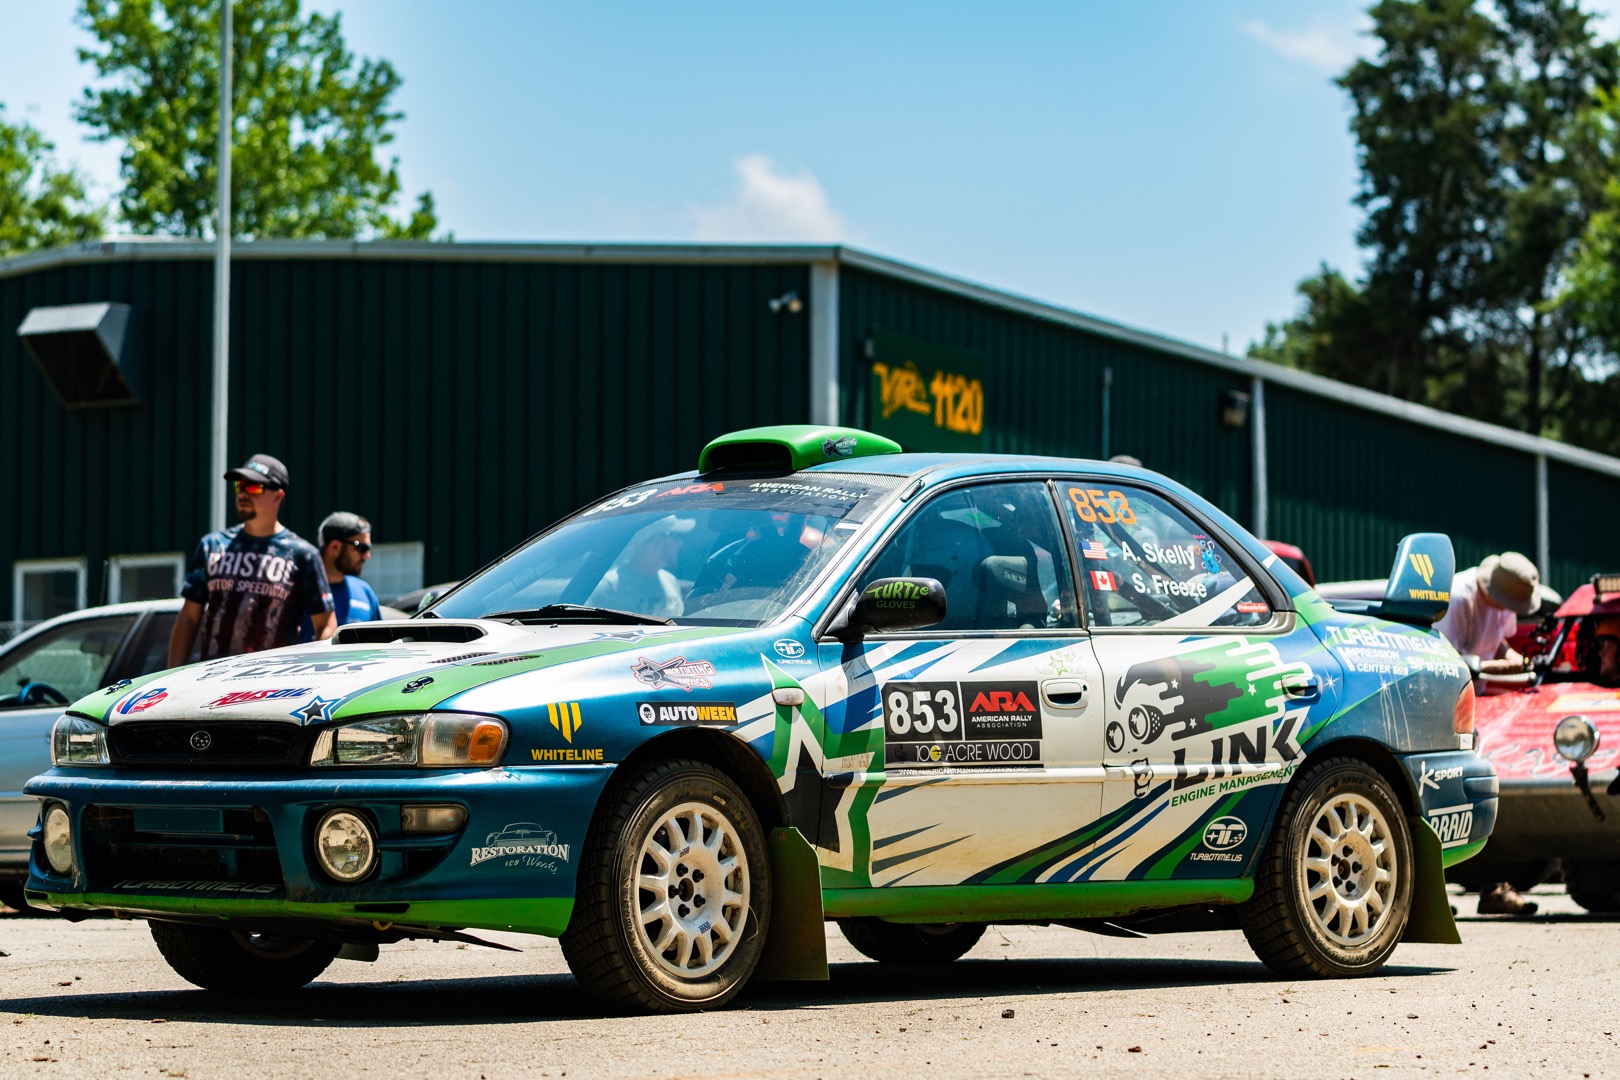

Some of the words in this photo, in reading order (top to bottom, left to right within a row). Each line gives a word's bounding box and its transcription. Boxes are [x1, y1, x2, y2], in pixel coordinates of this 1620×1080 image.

[931, 369, 984, 435] 1120
[750, 482, 822, 492] AMERICAN
[822, 487, 869, 499] RALLY
[751, 487, 849, 501] ASSOCIATION
[583, 488, 658, 517] 853
[1067, 487, 1137, 525] 853
[1122, 540, 1141, 562] A.
[1142, 541, 1196, 571] Skelly
[1131, 572, 1151, 594] S.
[1151, 574, 1208, 598] Freeze
[1409, 588, 1450, 602] WHITELINE
[876, 600, 916, 609] GLOVES
[1357, 663, 1391, 674] CENTER
[659, 705, 737, 721] AUTOWEEK
[887, 689, 959, 735] 853
[968, 691, 1037, 713] ARA
[971, 715, 1009, 723] AMERICAN
[531, 748, 604, 761] WHITELINE
[944, 744, 983, 761] ACRE
[986, 743, 1033, 760] WOOD
[1173, 716, 1299, 792] LINK
[1171, 785, 1216, 808] ENGINE
[1218, 763, 1300, 793] MANAGEMENT
[1430, 810, 1473, 842] BRAID
[470, 844, 571, 867] RESTORATION
[1189, 852, 1243, 862] TURBOTIME.US
